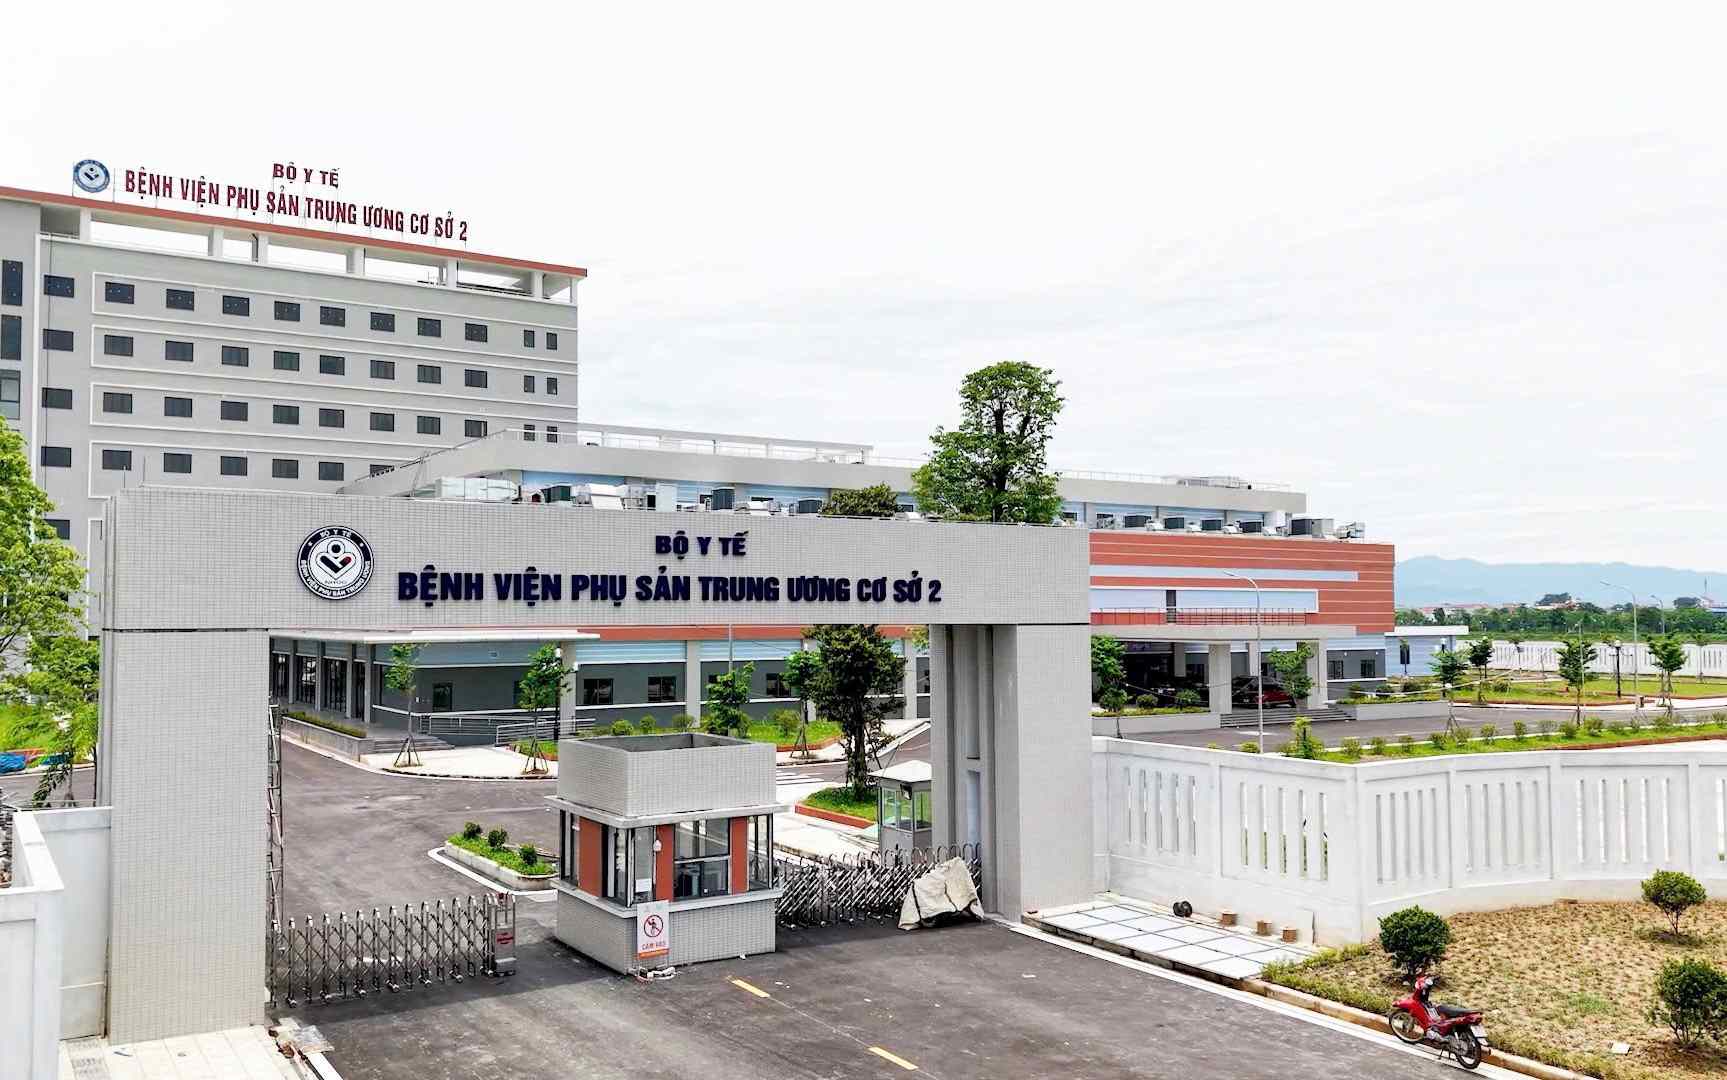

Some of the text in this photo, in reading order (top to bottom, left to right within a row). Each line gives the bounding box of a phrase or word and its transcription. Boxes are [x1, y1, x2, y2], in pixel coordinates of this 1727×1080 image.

[272, 162, 340, 188] BỘ Y TẾ
[125, 166, 173, 200] BỆNH
[180, 175, 220, 208] VIỆN
[227, 185, 260, 216] PHỤ
[266, 185, 299, 217] SẢN
[305, 197, 357, 226] TRUNG
[363, 205, 404, 232] ƯƠNG
[410, 213, 430, 235] CƠ
[435, 211, 454, 239] SỞ
[459, 221, 468, 241] 2
[655, 530, 749, 562] BỘ Y TẾ
[397, 564, 942, 608] BỆNH VIỆN PHỤ SẢN TRUNG ƯƠNG CƠ SỞ 2
